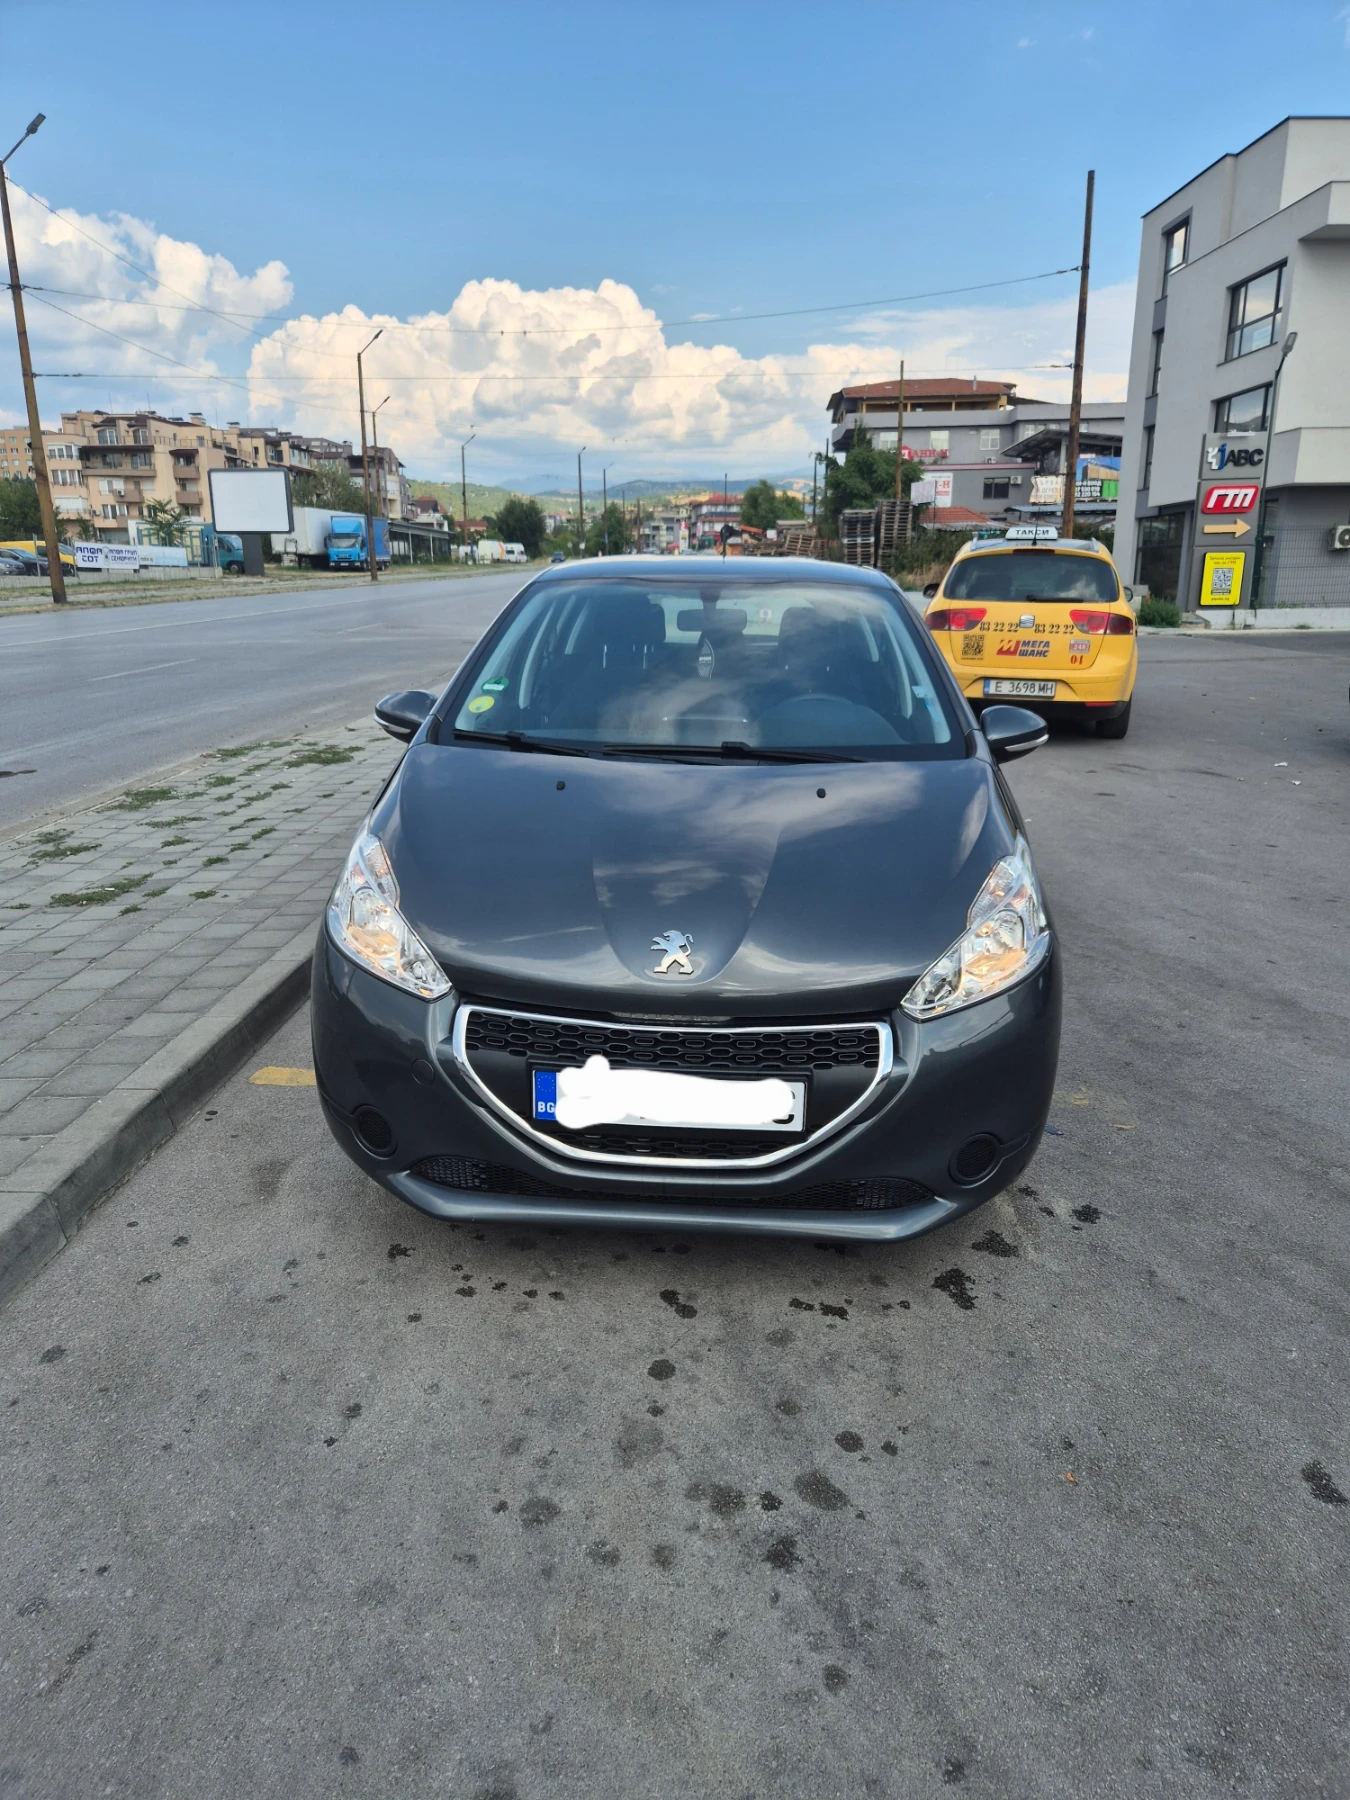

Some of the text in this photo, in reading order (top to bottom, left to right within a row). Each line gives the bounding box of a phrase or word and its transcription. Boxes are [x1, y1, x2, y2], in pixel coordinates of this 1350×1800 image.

[980, 621, 1019, 633] 83 22 22
[1034, 623, 1075, 635] 83 22 22
[1021, 640, 1050, 649] МЕГА
[1018, 649, 1050, 658] ШАНС
[995, 681, 1003, 692] E
[1008, 682, 1036, 693] 3698
[1038, 683, 1054, 694] MH
[537, 1101, 556, 1114] BG
